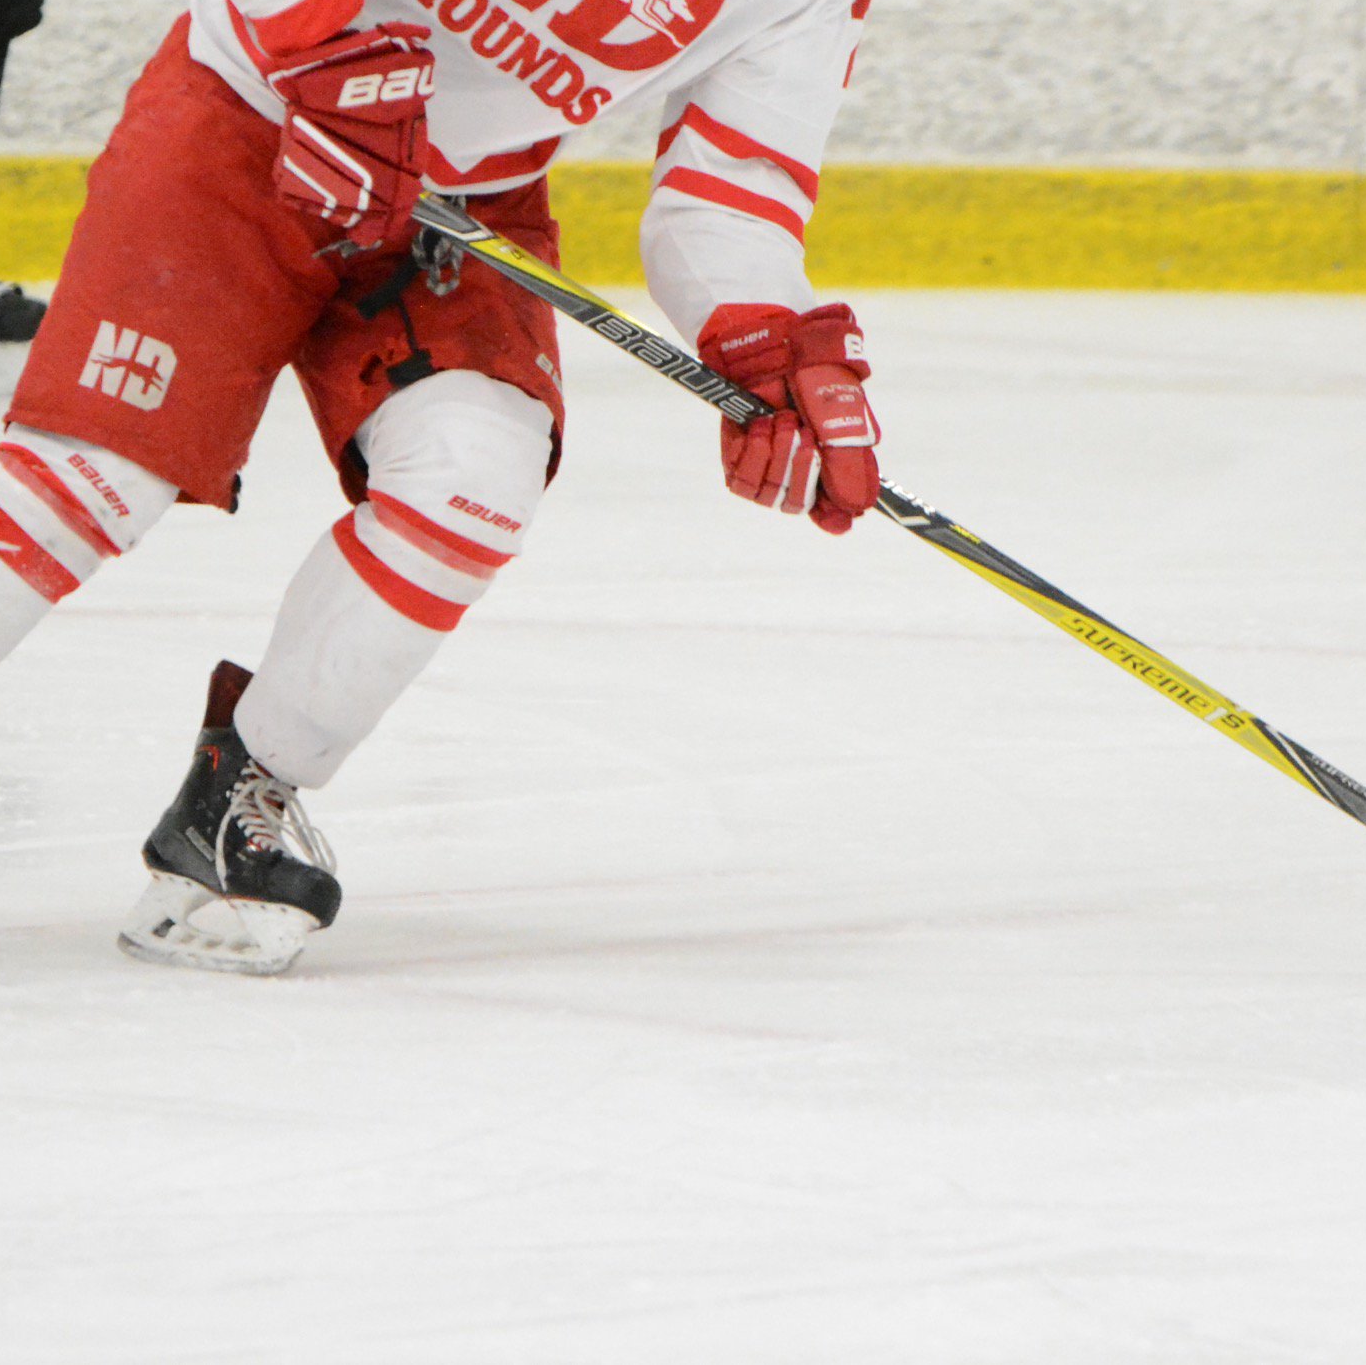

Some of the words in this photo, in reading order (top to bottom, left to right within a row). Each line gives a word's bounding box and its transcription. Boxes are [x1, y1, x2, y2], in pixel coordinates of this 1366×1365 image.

[336, 64, 435, 109] BAU
[77, 319, 179, 412] ND
[585, 311, 766, 425] BAUE
[67, 453, 131, 518] BAUER
[447, 494, 523, 535] BAUER
